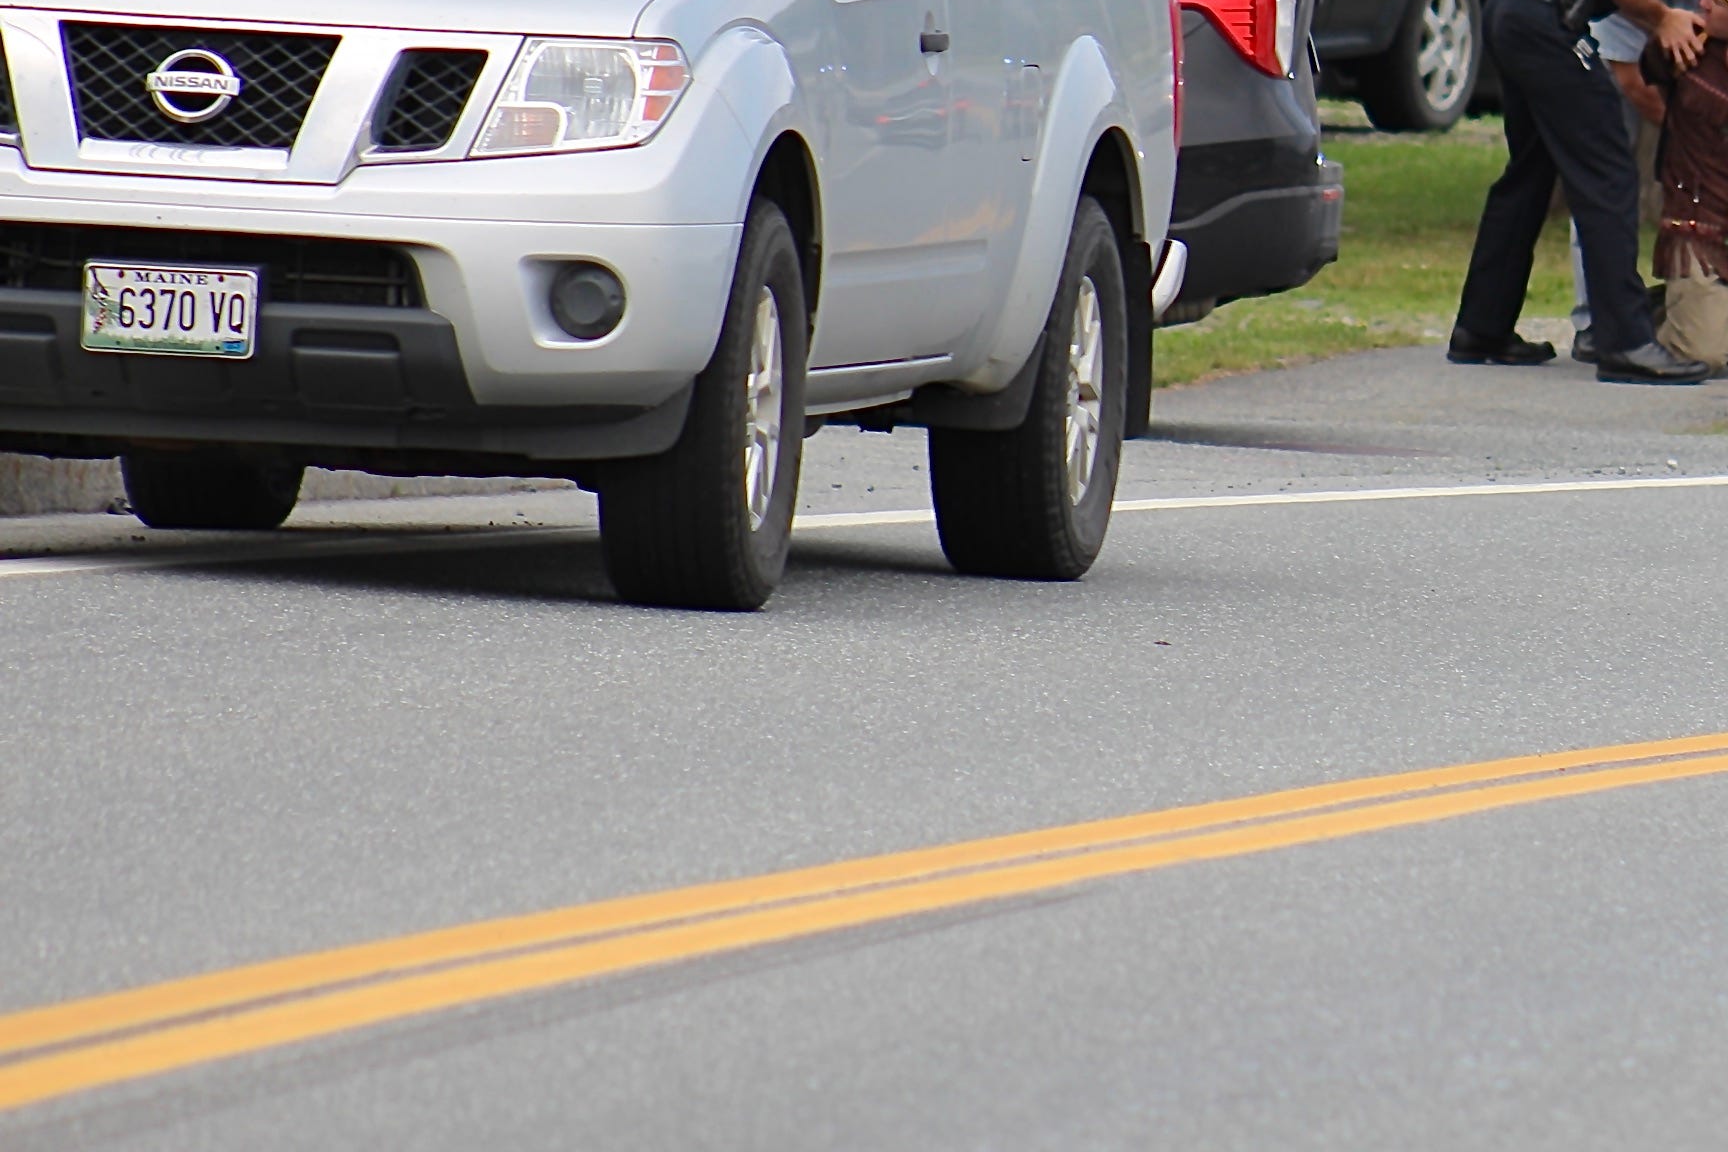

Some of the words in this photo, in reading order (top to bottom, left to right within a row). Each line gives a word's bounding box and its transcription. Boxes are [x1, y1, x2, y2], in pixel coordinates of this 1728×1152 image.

[155, 75, 229, 90] NISSAN
[134, 271, 209, 286] MAINE
[119, 287, 195, 332] 6370
[209, 291, 245, 334] VQ
